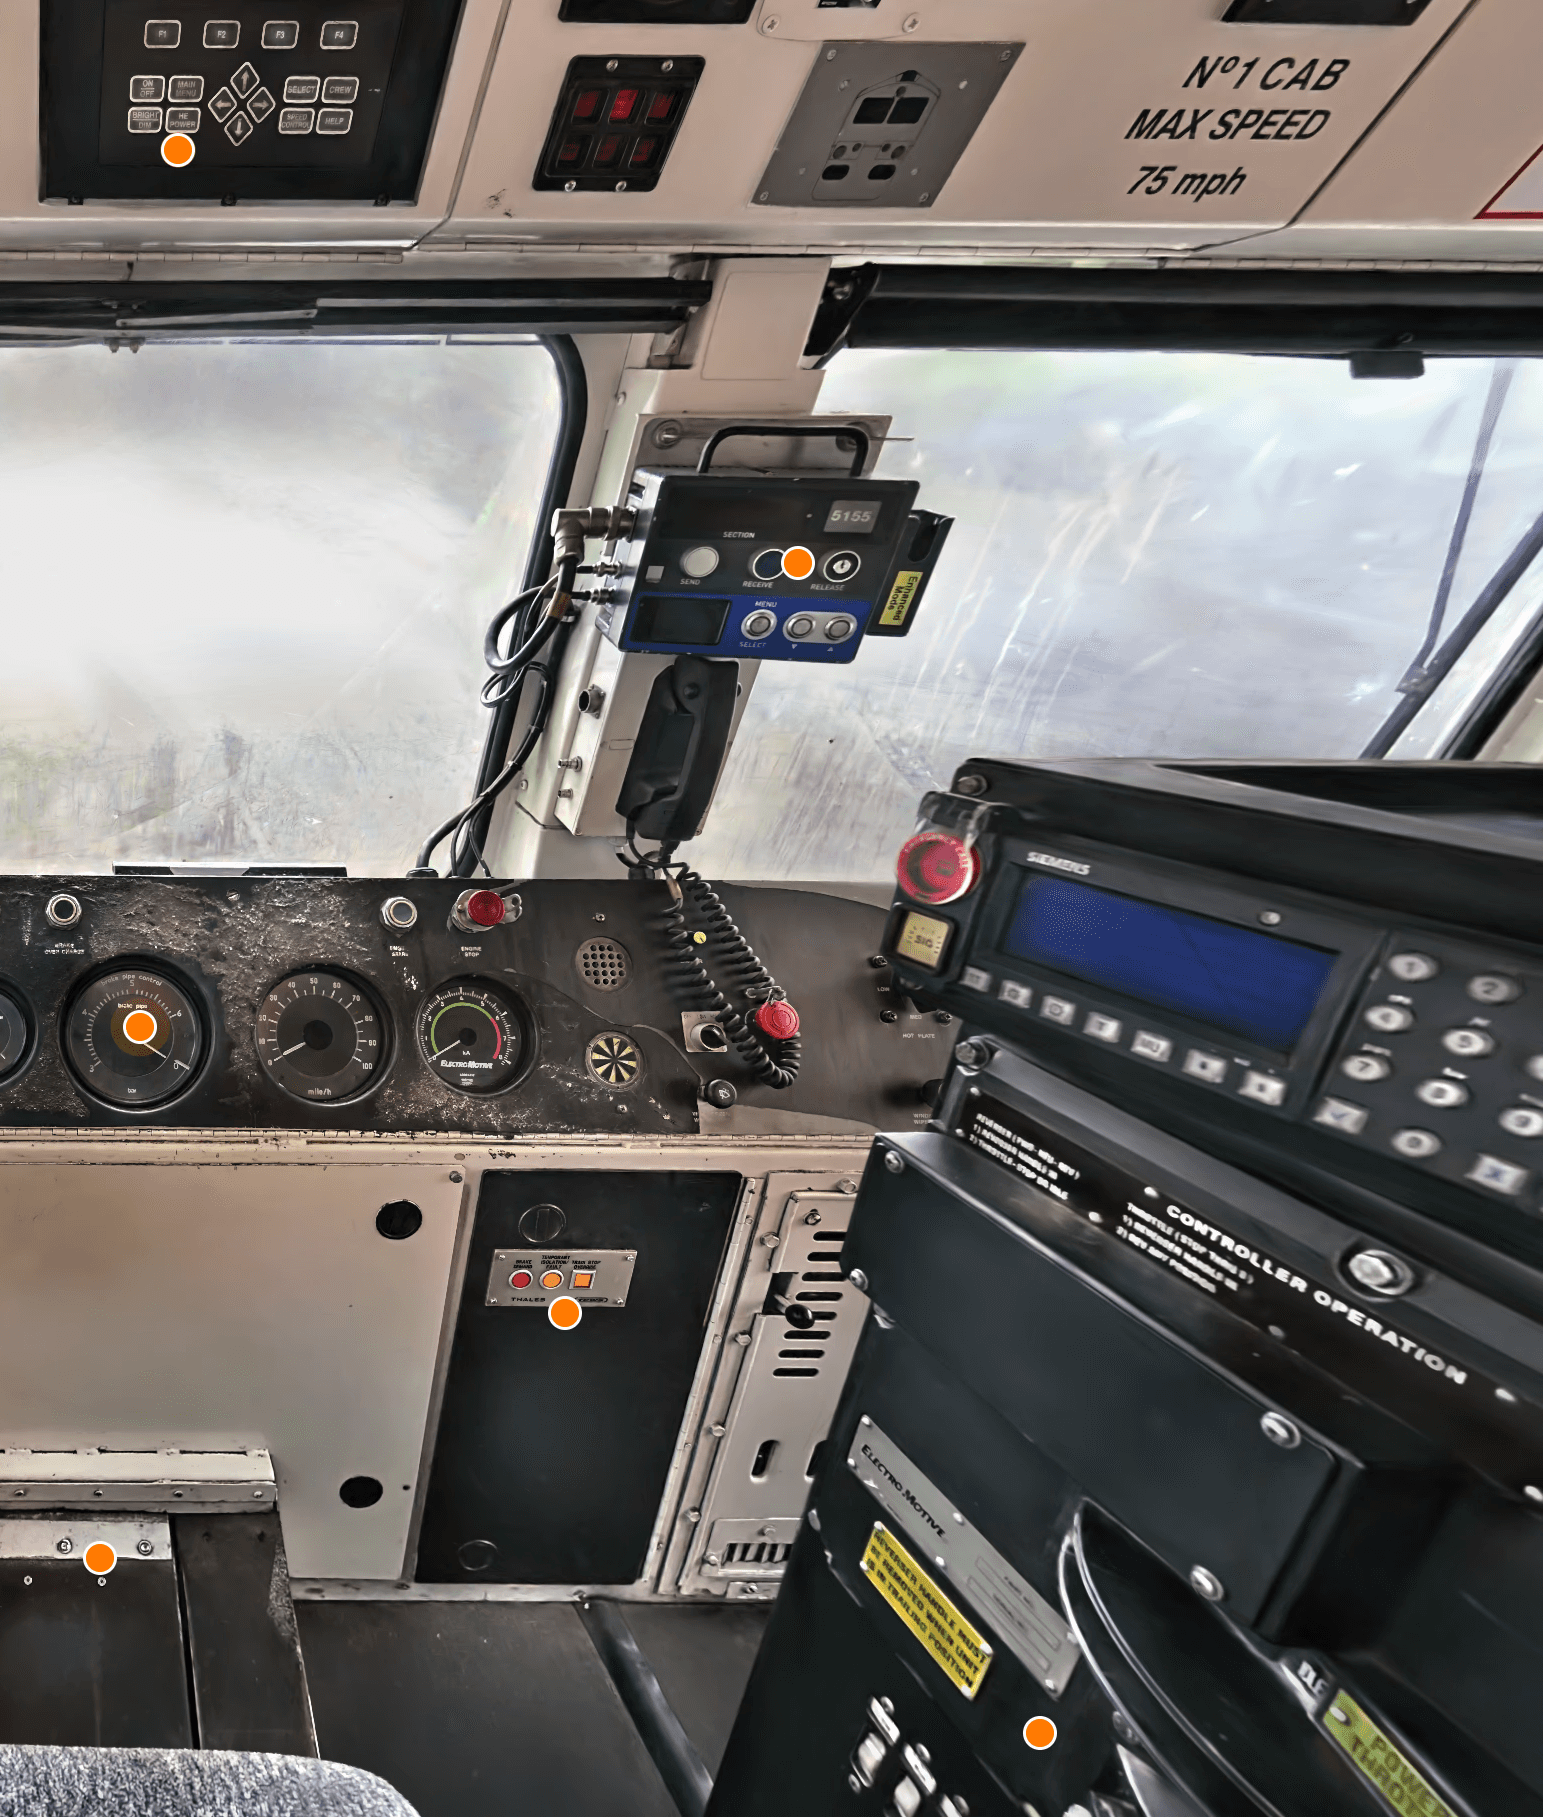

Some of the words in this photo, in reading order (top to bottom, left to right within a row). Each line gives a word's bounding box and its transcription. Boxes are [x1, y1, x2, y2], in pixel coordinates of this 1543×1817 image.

[158, 30, 167, 39] F1
[217, 30, 226, 39] F2
[275, 30, 285, 39] F3
[334, 30, 344, 39] F4
[1259, 56, 1351, 91] CAB
[177, 80, 196, 88] MAIN
[176, 89, 197, 97] MENU
[287, 85, 317, 94] SELECT
[329, 85, 352, 94] CREW
[132, 111, 159, 119] BRIGHT
[286, 113, 308, 121] SPEED
[138, 121, 152, 129] DIM
[169, 120, 196, 128] POWER
[281, 121, 311, 129] CONTROL
[325, 117, 344, 125] HELP
[1123, 108, 1215, 140] MAX
[1208, 108, 1332, 141] SPEED
[1126, 165, 1178, 195] 75
[1171, 165, 1248, 203] mph
[830, 509, 872, 522] 5155
[722, 531, 756, 539] SECTION
[680, 578, 701, 586] SEND
[742, 580, 774, 589] RECEIVE
[810, 583, 845, 591] RELEASE
[887, 585, 905, 610] Mode
[892, 576, 918, 621] Enhanced
[754, 600, 777, 608] MENU
[1026, 851, 1090, 876] SIEMENS
[138, 974, 163, 987] control
[307, 1088, 332, 1096] mile/h
[1166, 1204, 1309, 1293] CONTROLLER
[1312, 1289, 1468, 1385] OPERATION
[873, 1529, 918, 1585] REVERSER
[918, 1582, 956, 1631] HANDLE
[956, 1627, 986, 1666] MUST
[881, 1557, 925, 1612] REMOVED
[924, 1609, 954, 1647] WHEN
[954, 1644, 979, 1676] UNIT
[866, 1557, 875, 1572] IS
[876, 1568, 886, 1584] IN
[886, 1581, 928, 1633] TRAILING
[927, 1631, 973, 1688] POSITION
